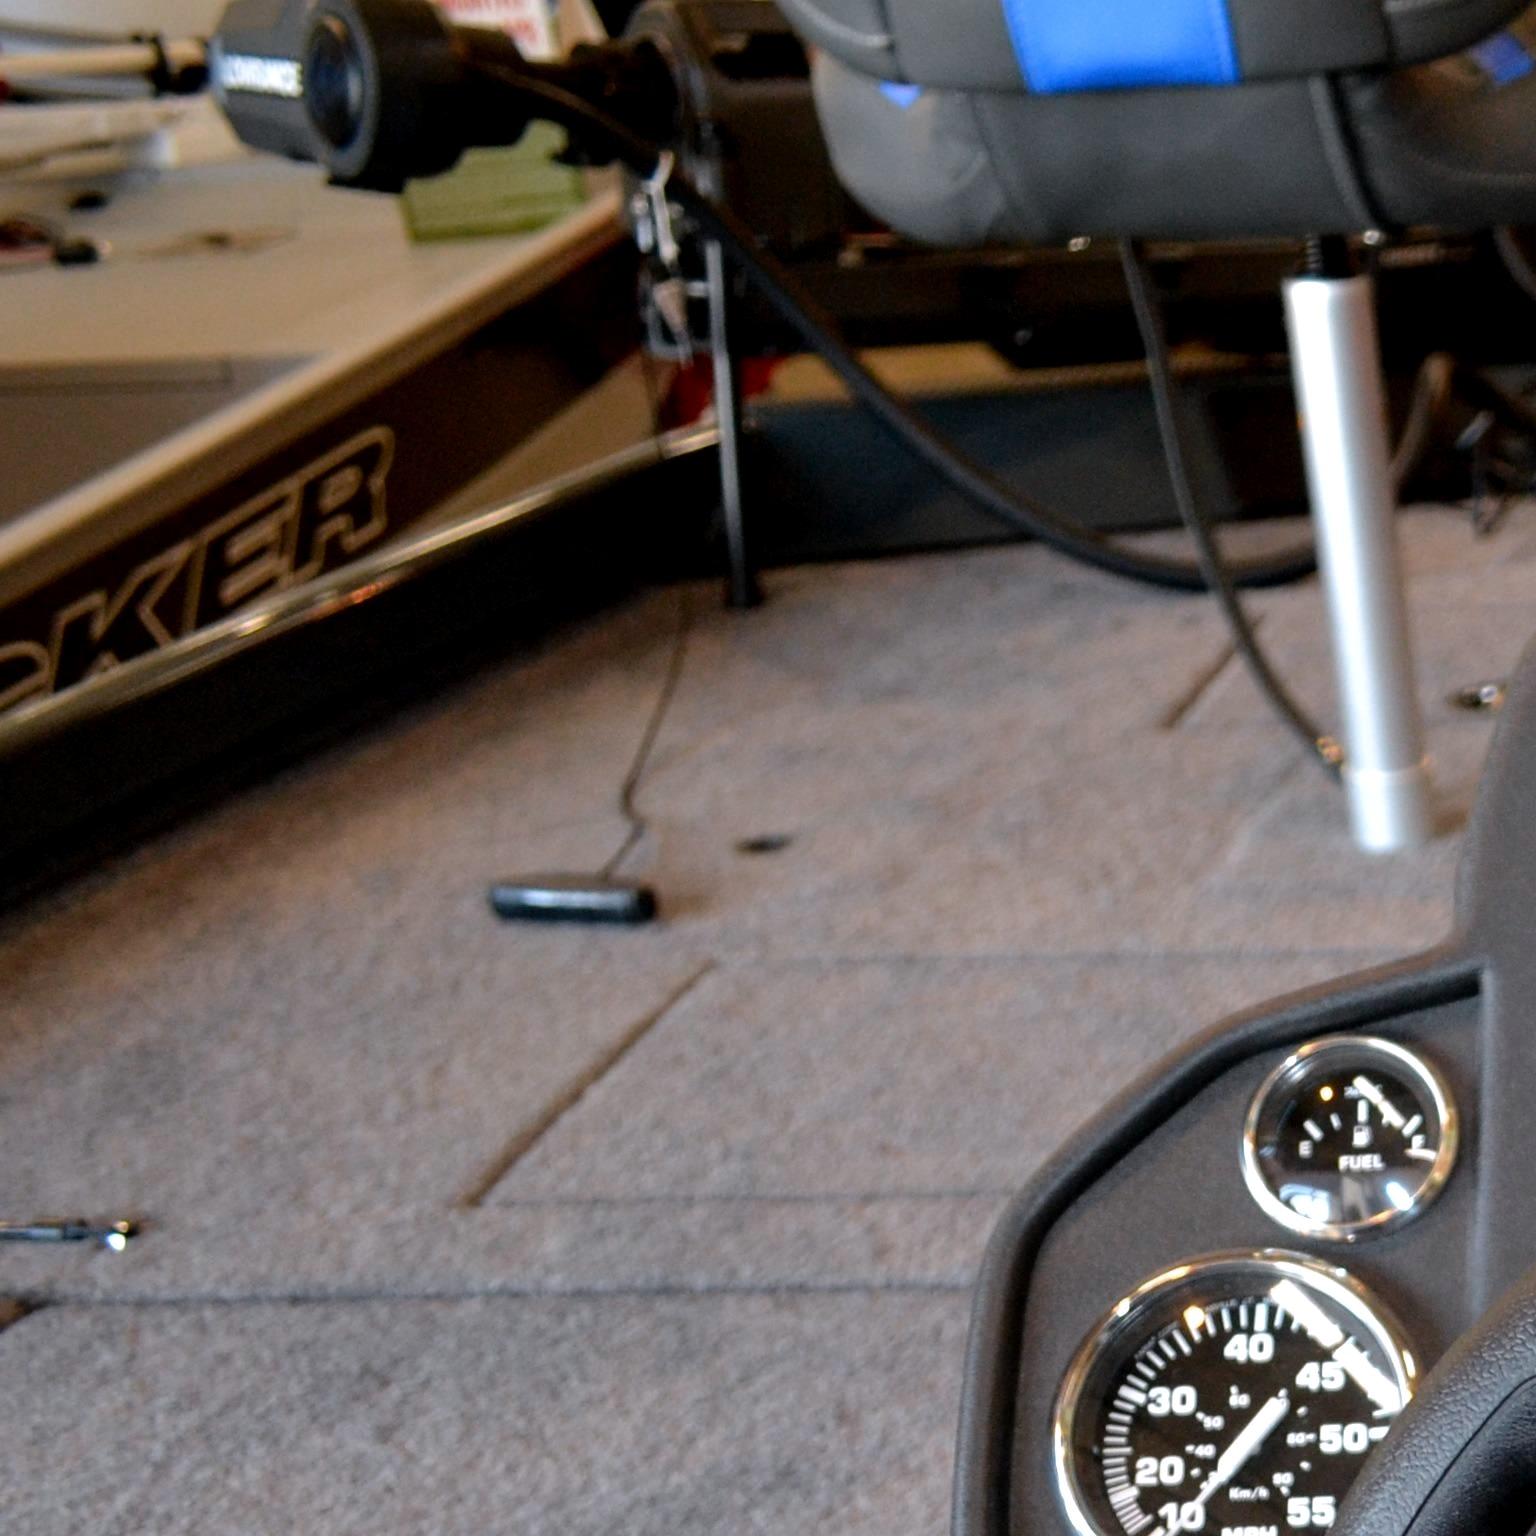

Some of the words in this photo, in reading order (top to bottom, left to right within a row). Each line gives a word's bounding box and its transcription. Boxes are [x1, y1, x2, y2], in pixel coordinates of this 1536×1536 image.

[1338, 1153, 1384, 1171] FUEL
[1223, 1333, 1275, 1364] 40
[1295, 1361, 1346, 1392] 45
[1147, 1385, 1198, 1416] 30
[1318, 1422, 1368, 1453] 50
[1134, 1455, 1186, 1486] 20
[1157, 1501, 1206, 1531] 10
[1286, 1494, 1336, 1528] 55
